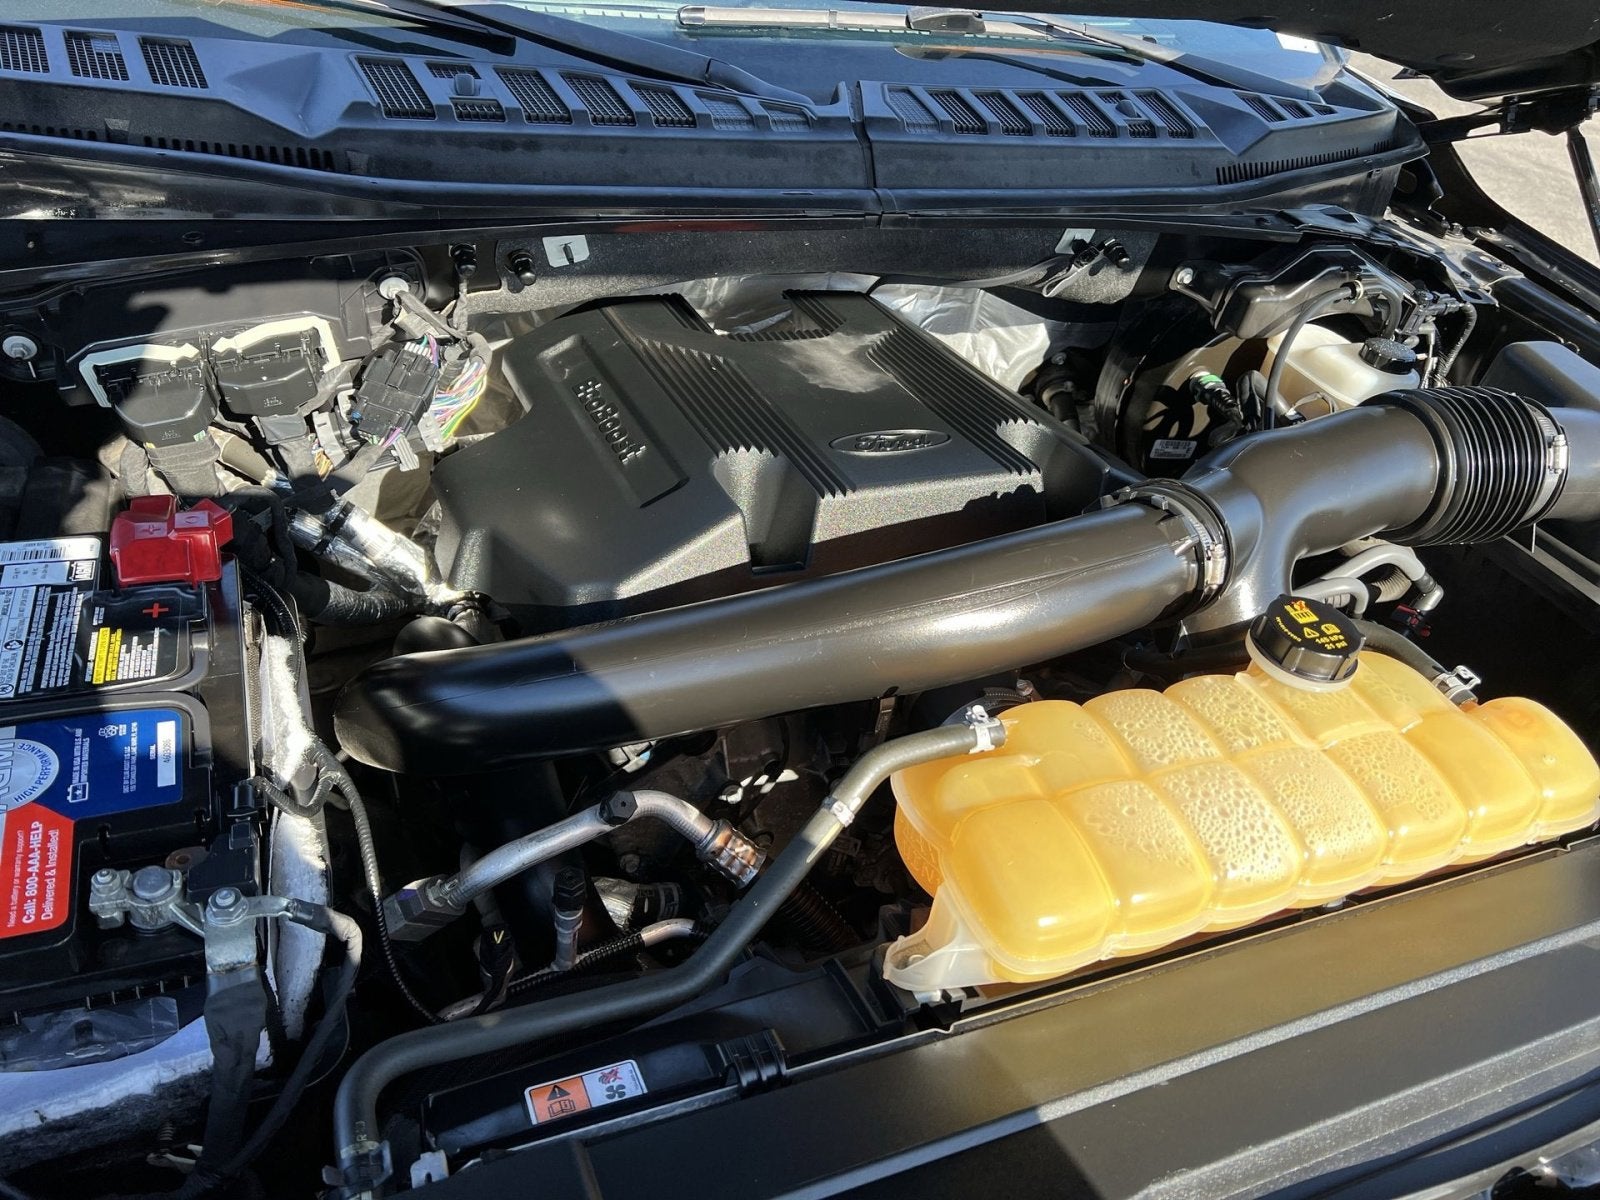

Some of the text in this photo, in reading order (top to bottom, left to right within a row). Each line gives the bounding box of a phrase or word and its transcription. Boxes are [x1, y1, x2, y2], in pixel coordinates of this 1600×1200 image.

[854, 432, 933, 453] Ford
[14, 742, 52, 802] HIGH PERFORMANCE
[14, 854, 24, 877] warranty
[22, 821, 43, 923] Call: 800-AAA-HELP
[41, 829, 59, 920] Delivered & Installed!
[10, 885, 21, 905] battery
[7, 911, 17, 927] Need
